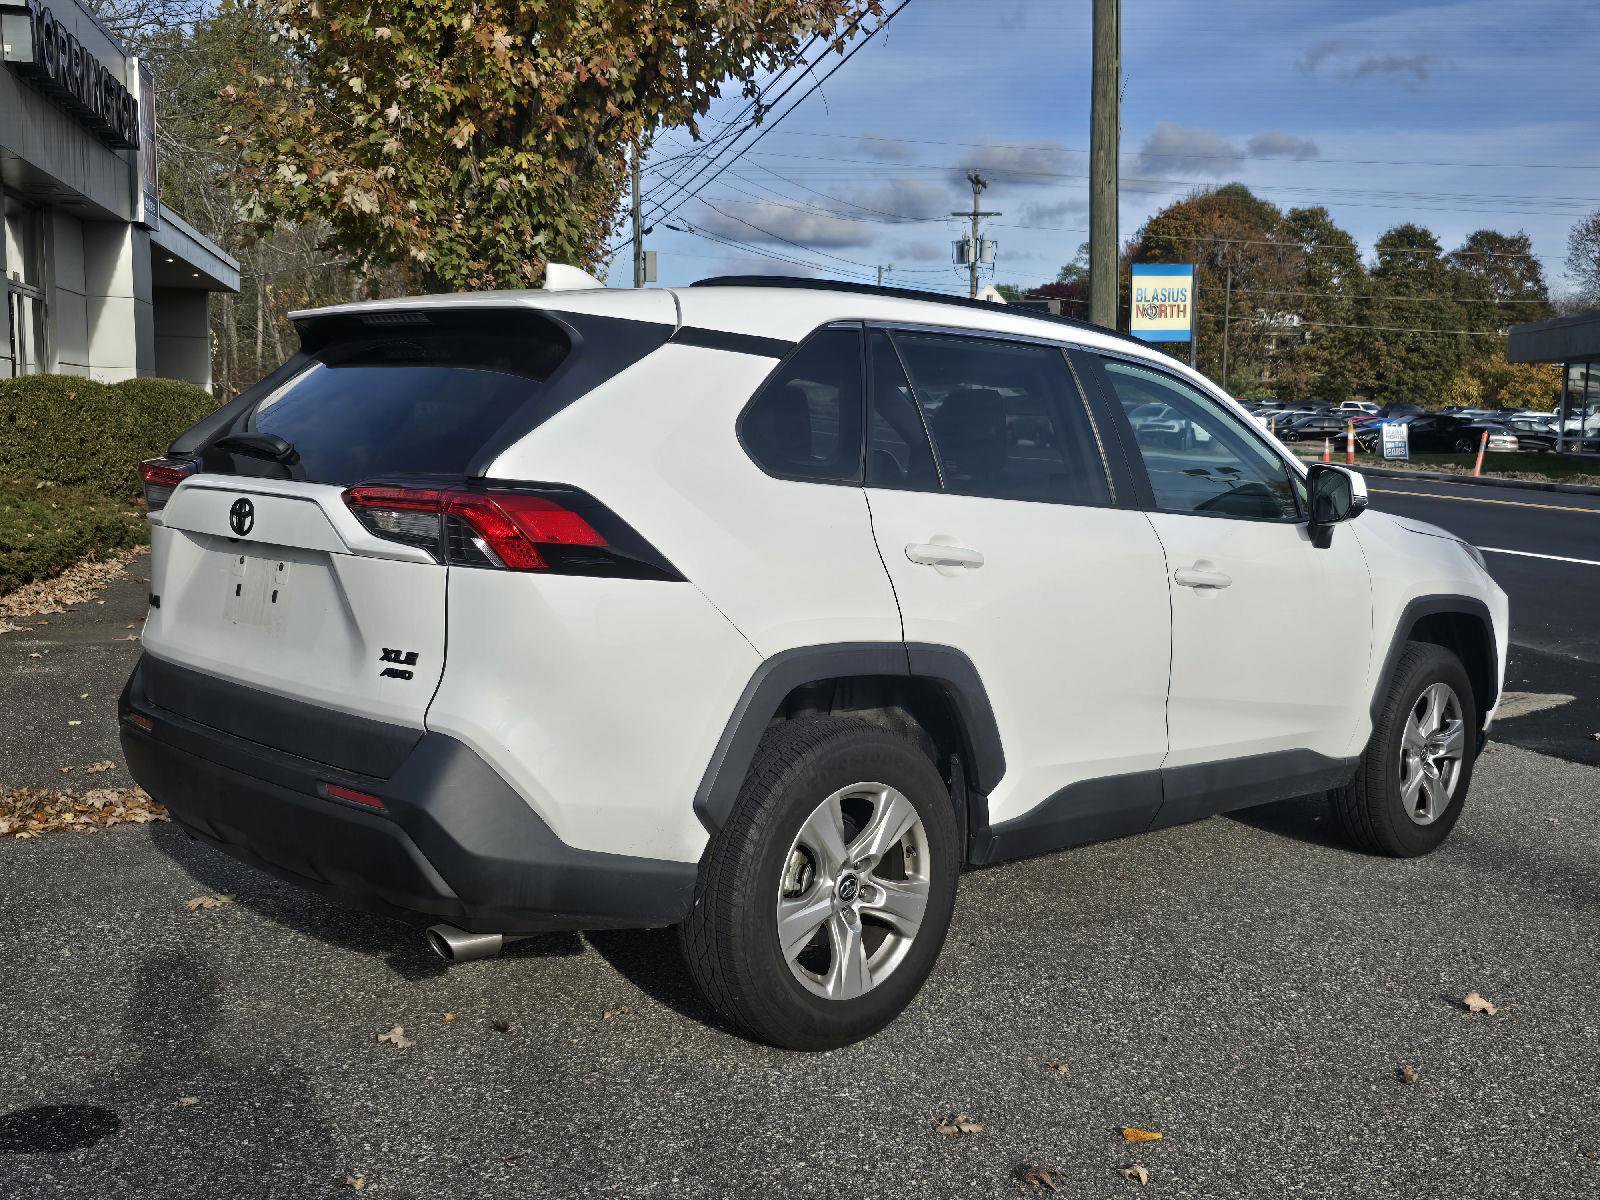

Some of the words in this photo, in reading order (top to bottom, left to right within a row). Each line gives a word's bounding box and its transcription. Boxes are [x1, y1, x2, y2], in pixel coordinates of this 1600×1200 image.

[1135, 287, 1187, 302] BLASIUS
[1135, 303, 1187, 320] NORTH
[379, 647, 419, 666] XLE
[379, 667, 414, 681] AWD
